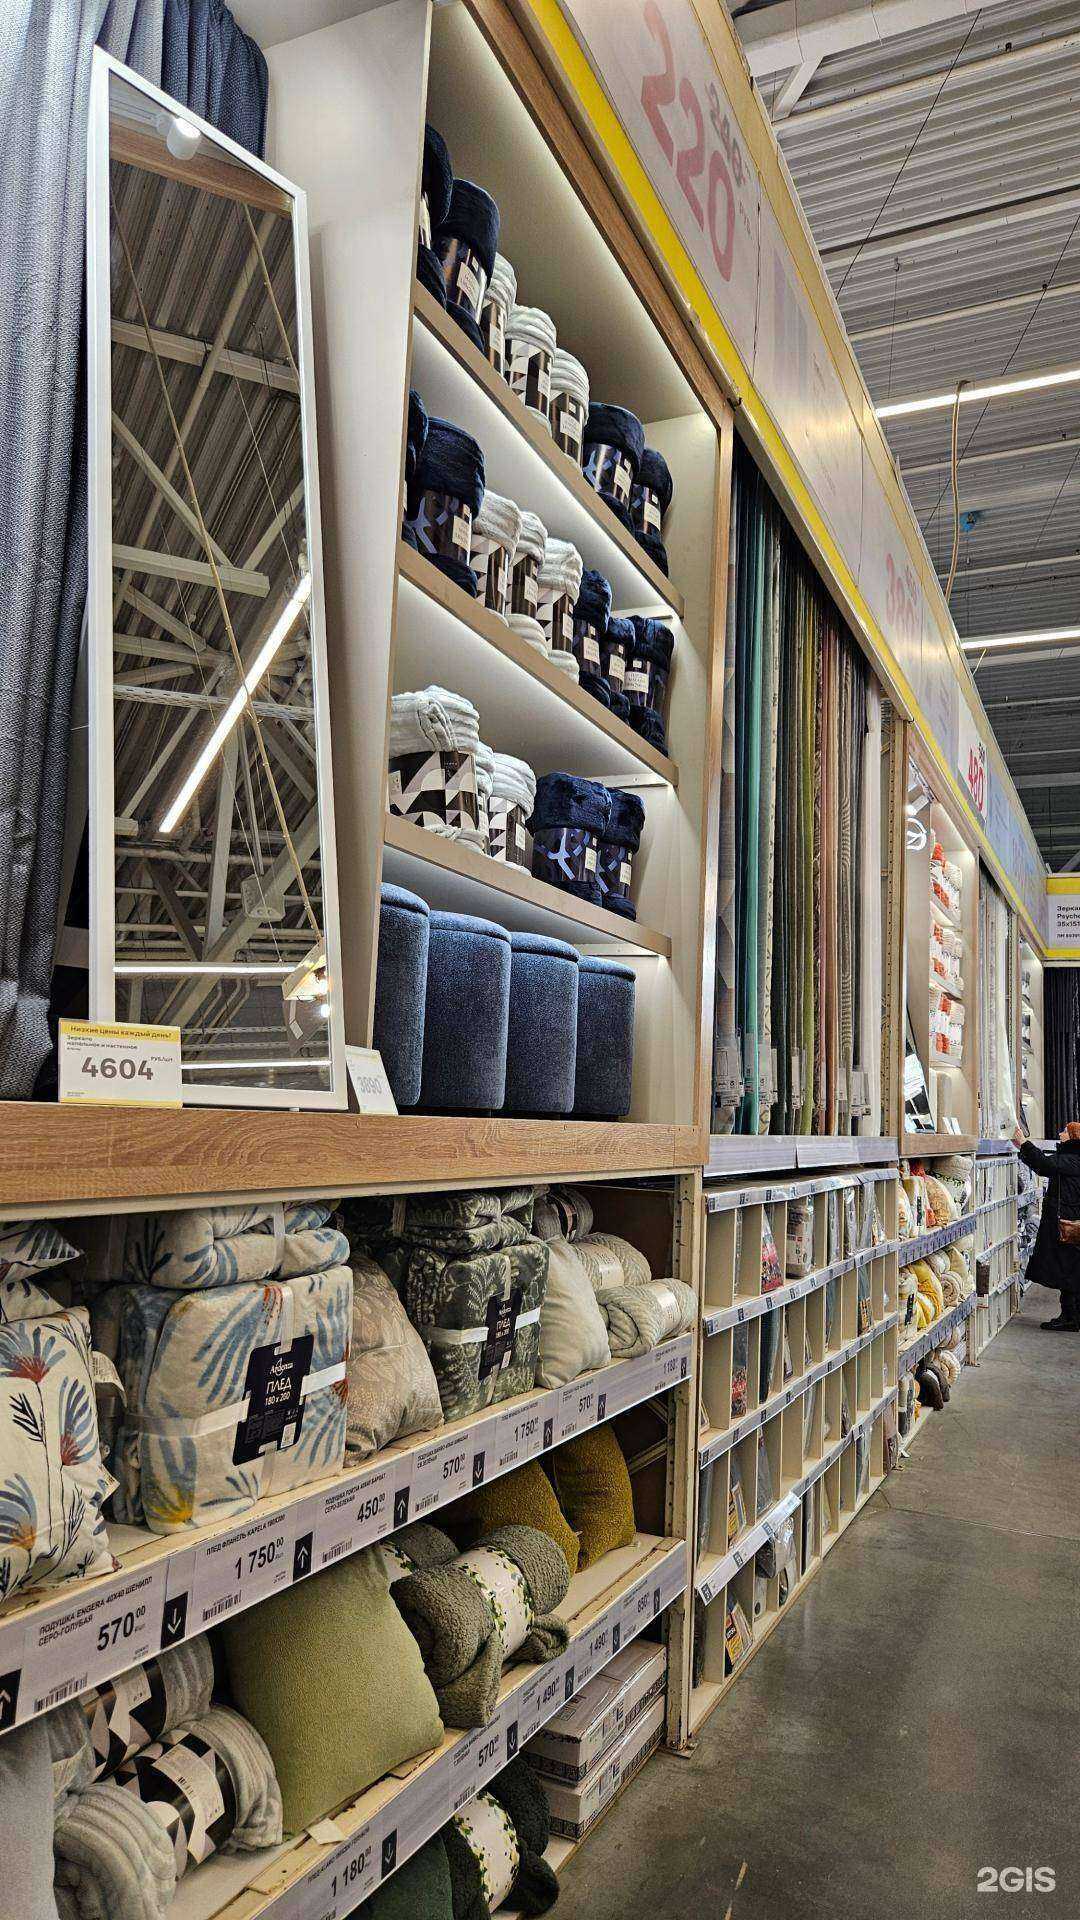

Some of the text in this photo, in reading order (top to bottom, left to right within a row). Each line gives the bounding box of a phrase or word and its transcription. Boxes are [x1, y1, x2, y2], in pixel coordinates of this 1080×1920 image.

[641, 2, 735, 282] 220
[71, 1025, 98, 1034] Низкие
[99, 1028, 119, 1036] цены
[120, 1030, 150, 1038] каждый
[81, 1056, 154, 1080] 4604
[266, 1377, 292, 1394] ПЛЕД
[443, 1456, 460, 1479] 570
[357, 1496, 378, 1522] 450
[235, 1557, 242, 1579] 1
[248, 1541, 276, 1573] 750
[39, 1613, 75, 1636] ПОДУШКА
[125, 1576, 153, 1595] ШЕНИЛЛ
[38, 1614, 93, 1647] СЕРО-ГОЛУБАЯ
[97, 1612, 135, 1651] 570
[478, 1740, 495, 1767] 570
[331, 1876, 337, 1898] 1
[342, 1853, 365, 1886] 180
